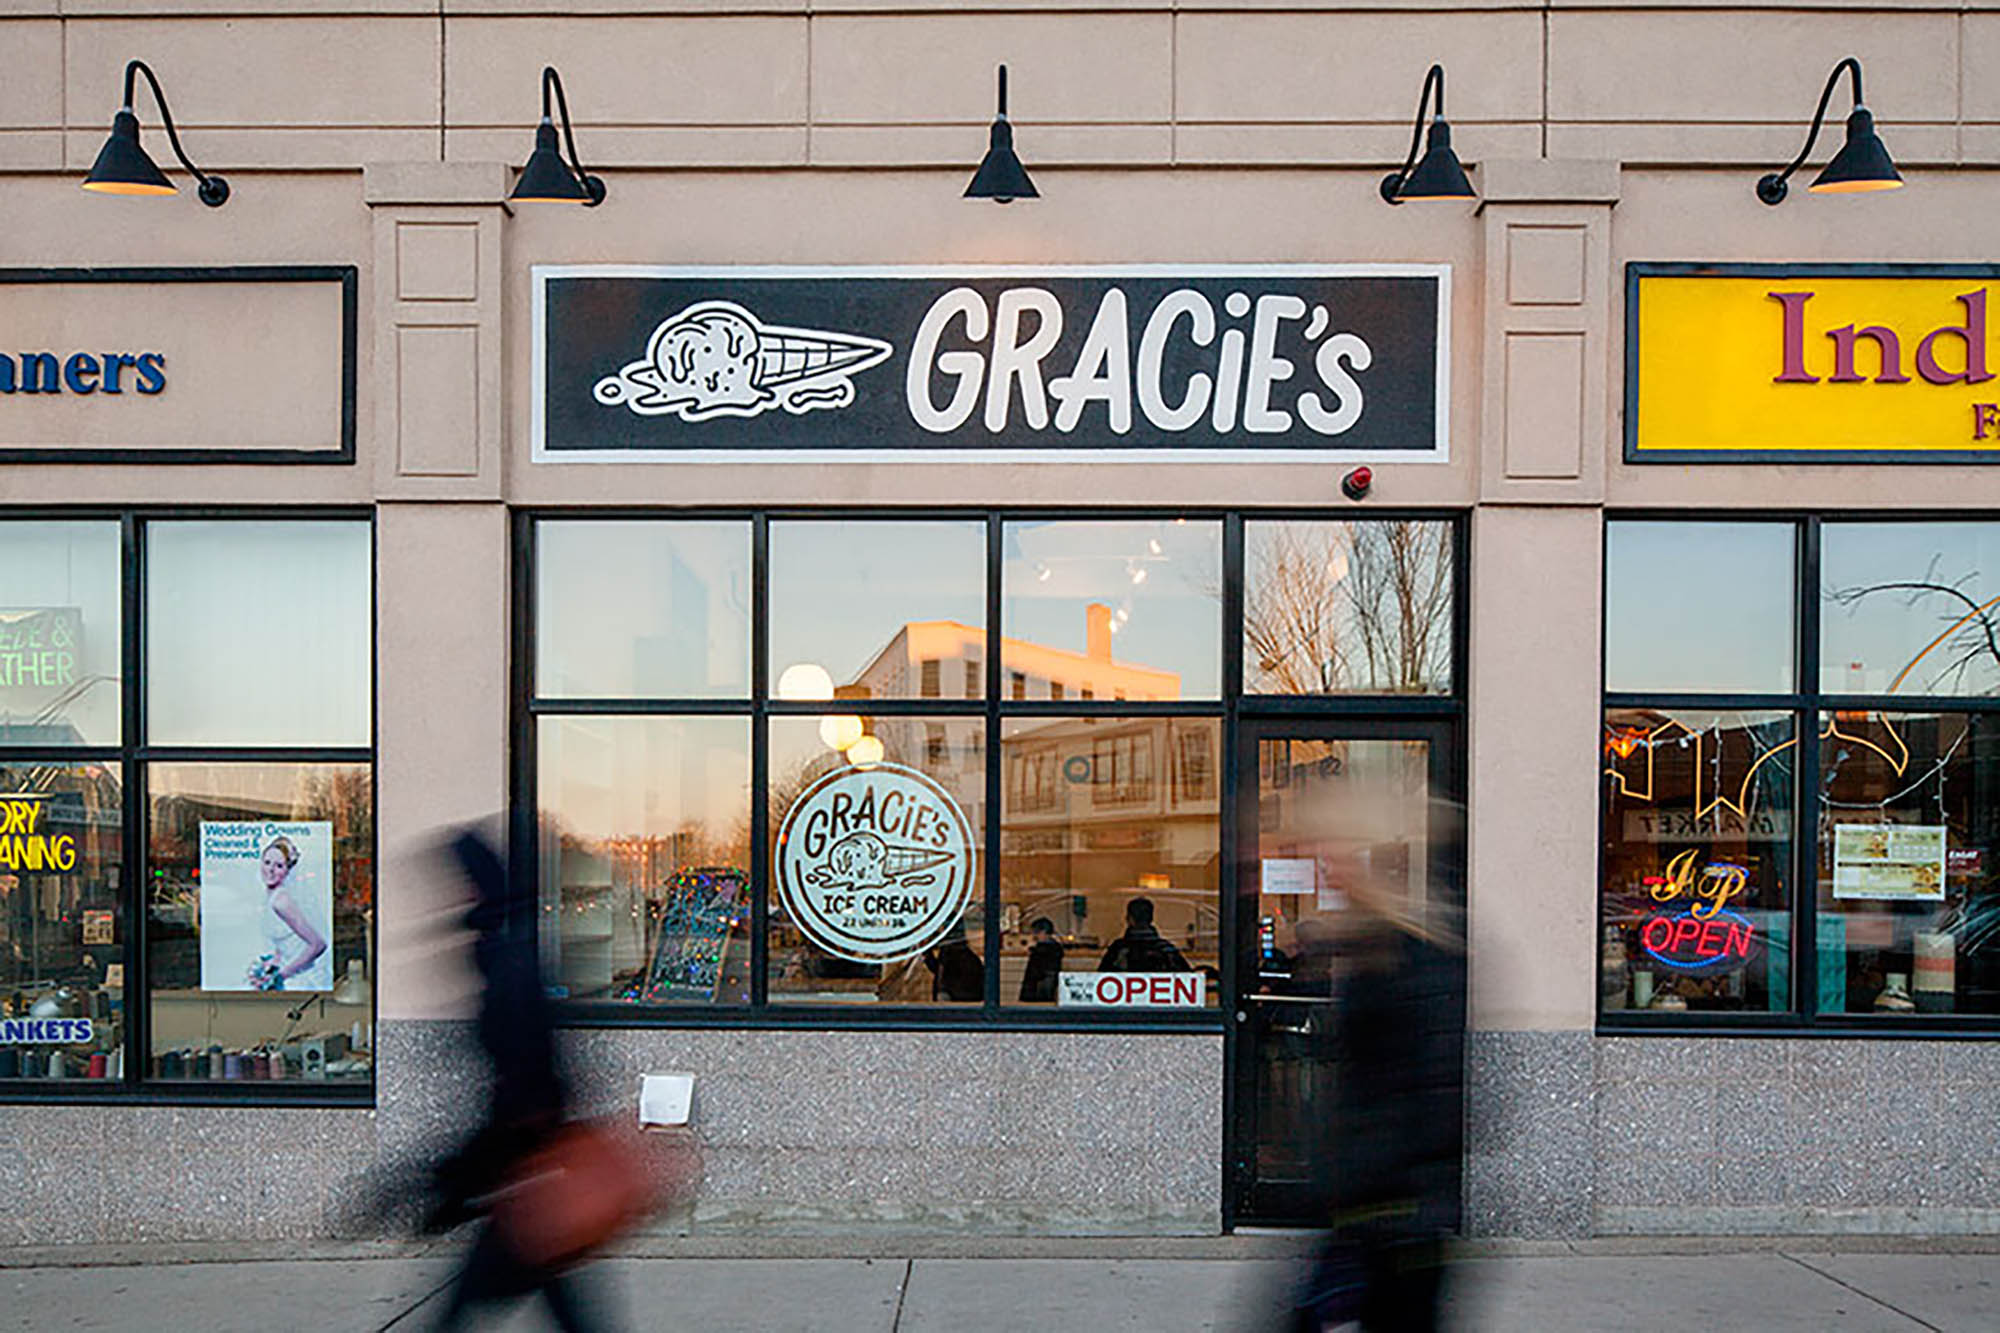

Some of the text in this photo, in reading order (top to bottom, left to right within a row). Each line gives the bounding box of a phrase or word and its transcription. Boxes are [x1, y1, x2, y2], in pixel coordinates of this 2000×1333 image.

[1768, 287, 1997, 386] Ind
[1972, 403, 2000, 440] F
[204, 823, 262, 838] Wedding
[204, 837, 249, 849] Cleaned
[205, 850, 260, 861] Preserved
[823, 895, 928, 914] ICE CREAM
[1642, 916, 1754, 957] OPEN
[1096, 976, 1198, 1004] OPEN
[0, 1019, 91, 1041] NKETS
